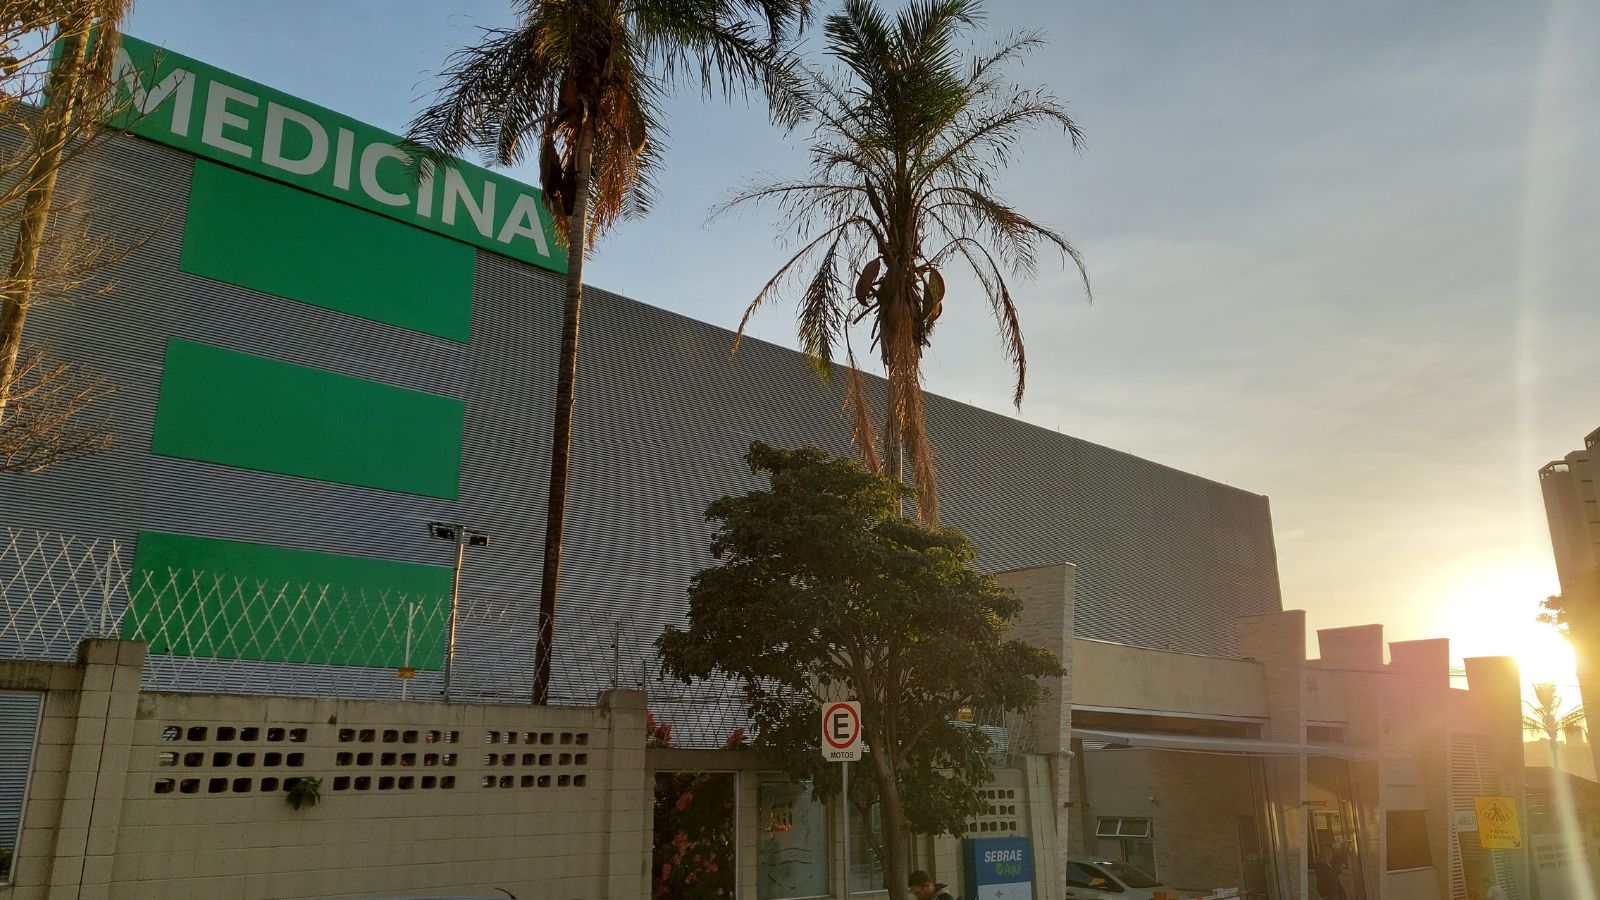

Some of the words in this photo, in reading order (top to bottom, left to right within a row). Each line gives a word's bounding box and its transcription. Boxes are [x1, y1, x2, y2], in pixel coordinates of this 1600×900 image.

[105, 46, 551, 258] MEDICINA
[833, 713, 850, 739] E
[830, 751, 854, 759] MOTOS
[984, 849, 1023, 863] SEBRAE
